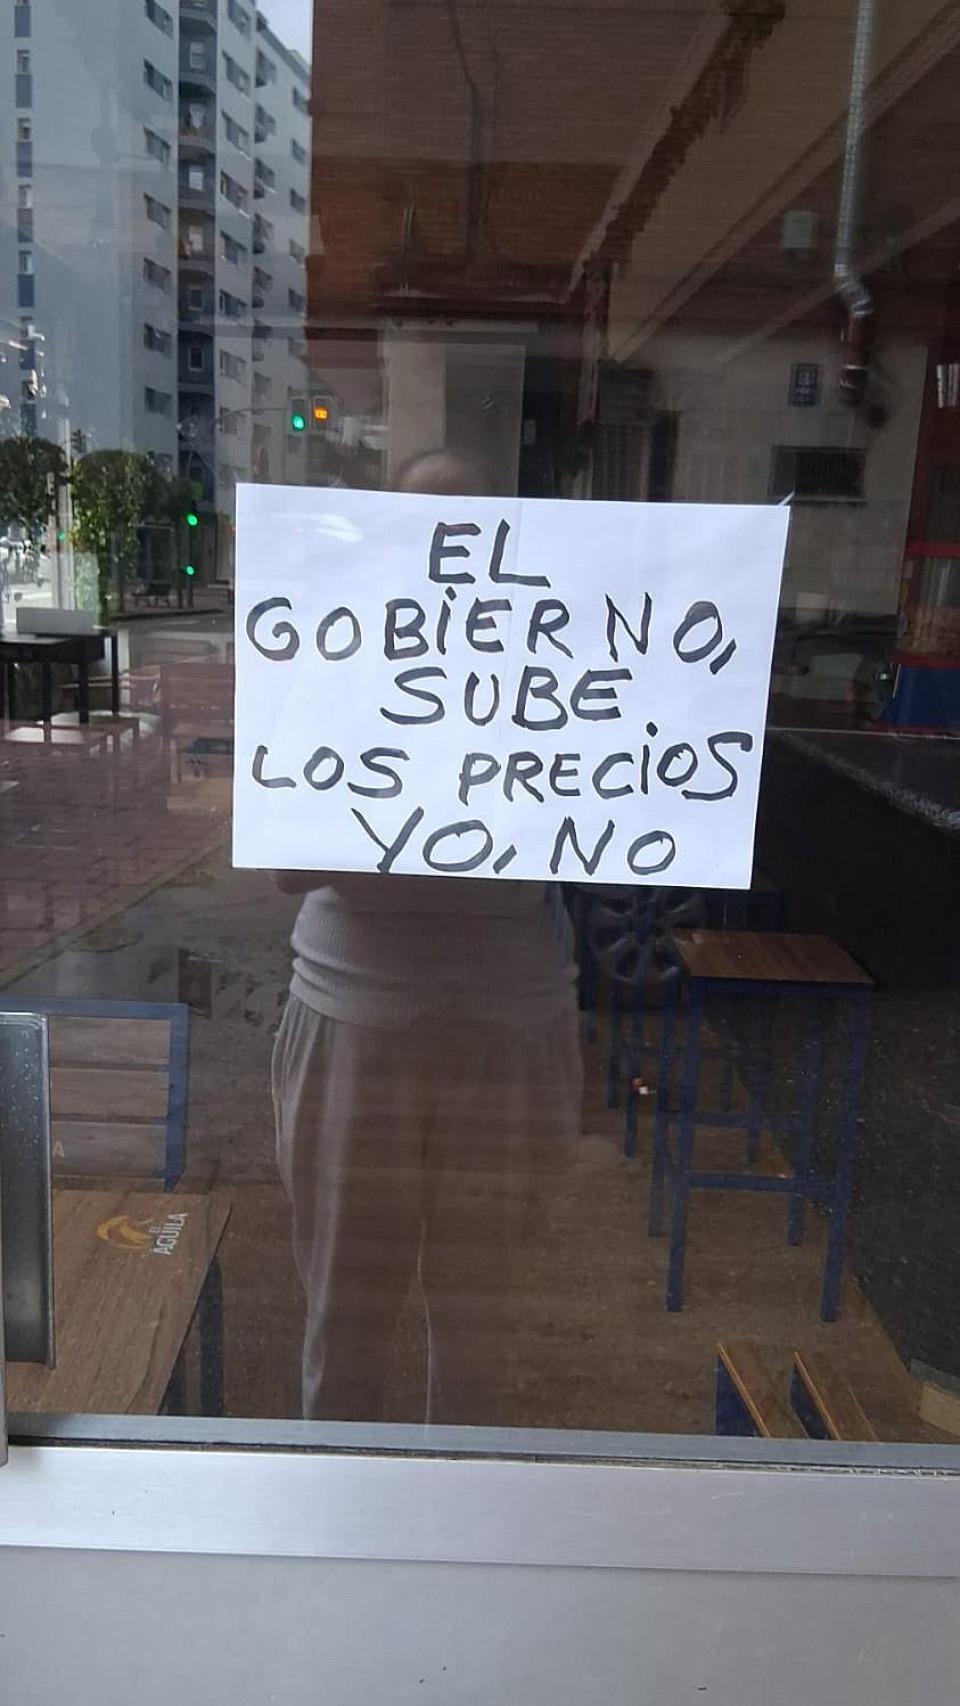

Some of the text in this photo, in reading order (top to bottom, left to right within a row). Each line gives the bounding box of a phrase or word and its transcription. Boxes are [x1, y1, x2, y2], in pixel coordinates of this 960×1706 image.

[428, 518, 551, 588] EL
[246, 587, 737, 675] GOBIERNO,
[380, 665, 633, 732] SUBE
[252, 722, 753, 806] LOS PRECIOS
[351, 807, 676, 876] YO, NO
